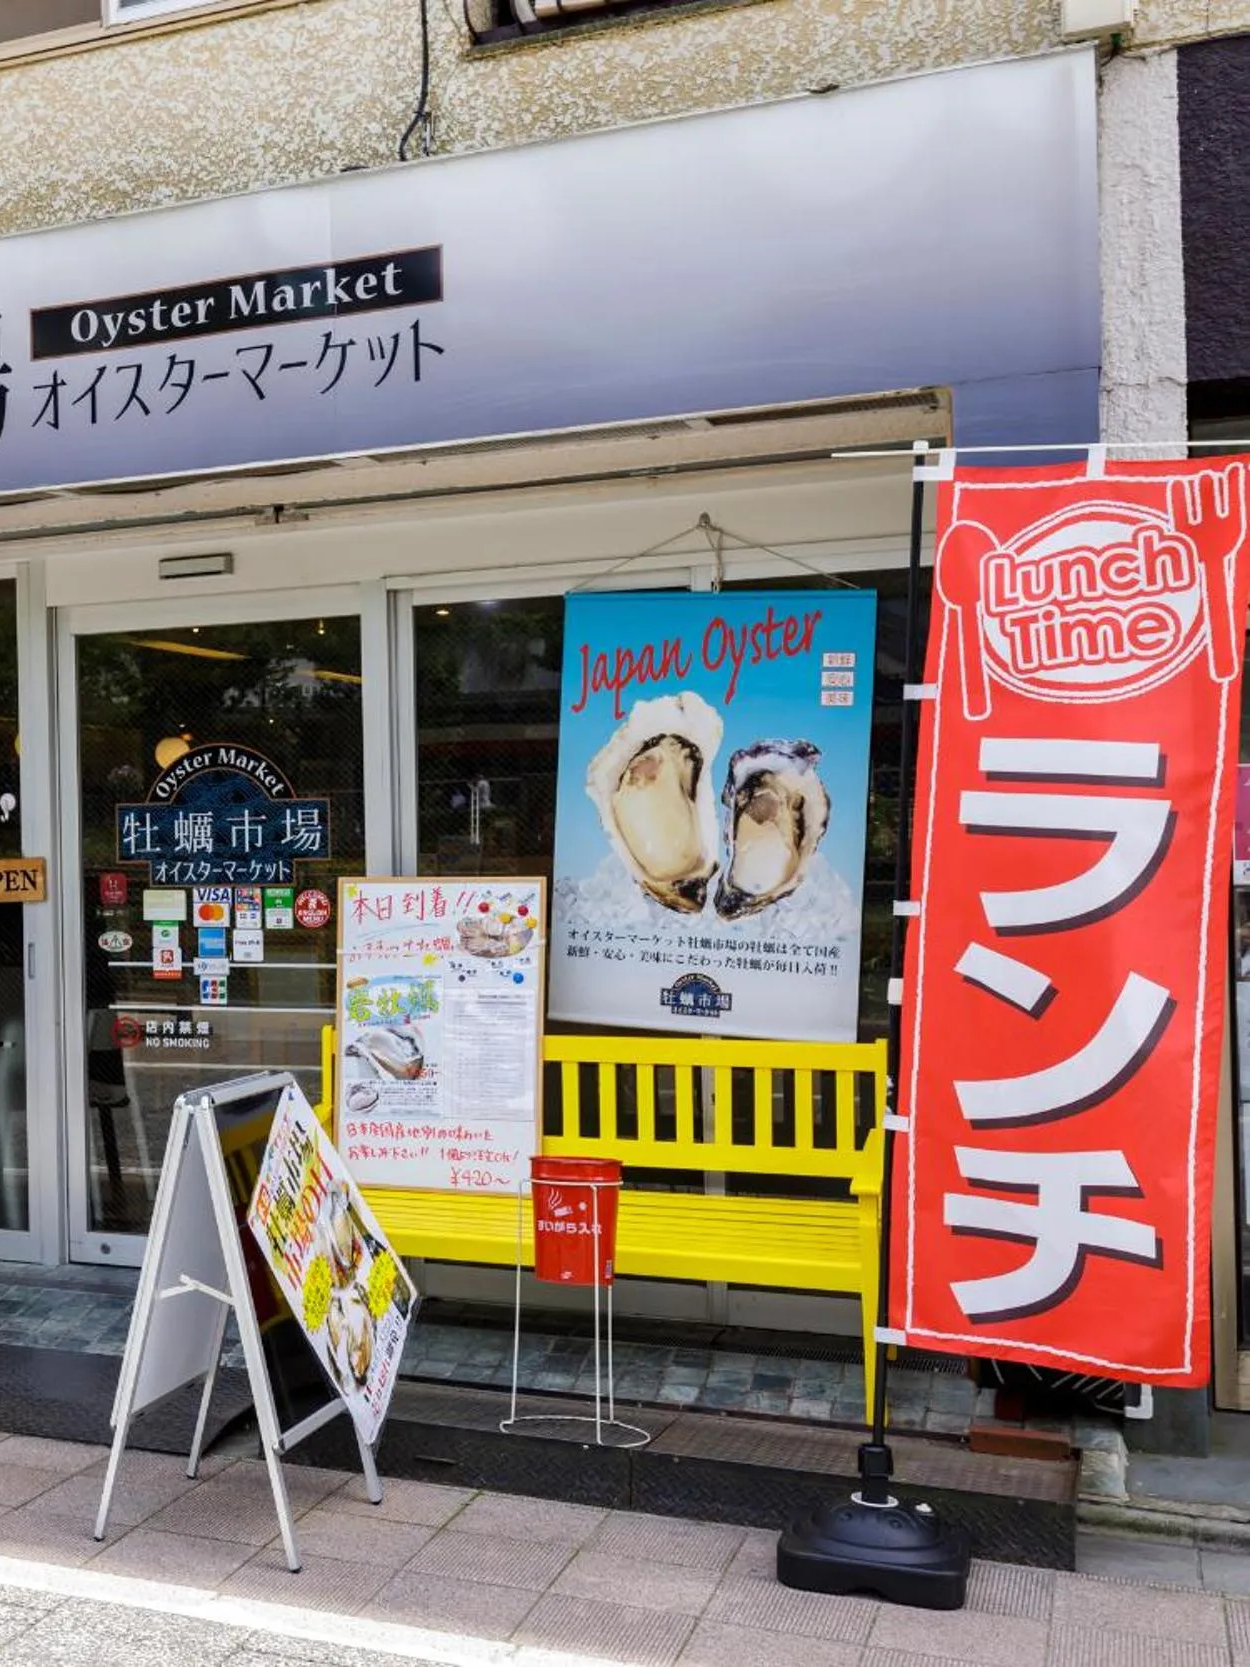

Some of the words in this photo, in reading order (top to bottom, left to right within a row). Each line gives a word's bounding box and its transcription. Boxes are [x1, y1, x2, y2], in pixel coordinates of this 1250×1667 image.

[70, 294, 215, 348] Oyster
[229, 262, 404, 320] Market
[31, 318, 445, 430] オイスターマーケット
[990, 529, 1190, 614] Lunch
[572, 635, 693, 719] Japan
[701, 606, 822, 705] Oyster
[1006, 604, 1175, 670] Time
[155, 751, 214, 799] Oyster
[217, 747, 285, 796] Market
[122, 808, 323, 855] 牡蠣市場
[154, 860, 291, 883] オイスターマーケット
[197, 887, 231, 900] VISA
[145, 1036, 160, 1048] NO
[162, 1037, 210, 1048] SMOKING
[944, 737, 1175, 1321] ランチ
